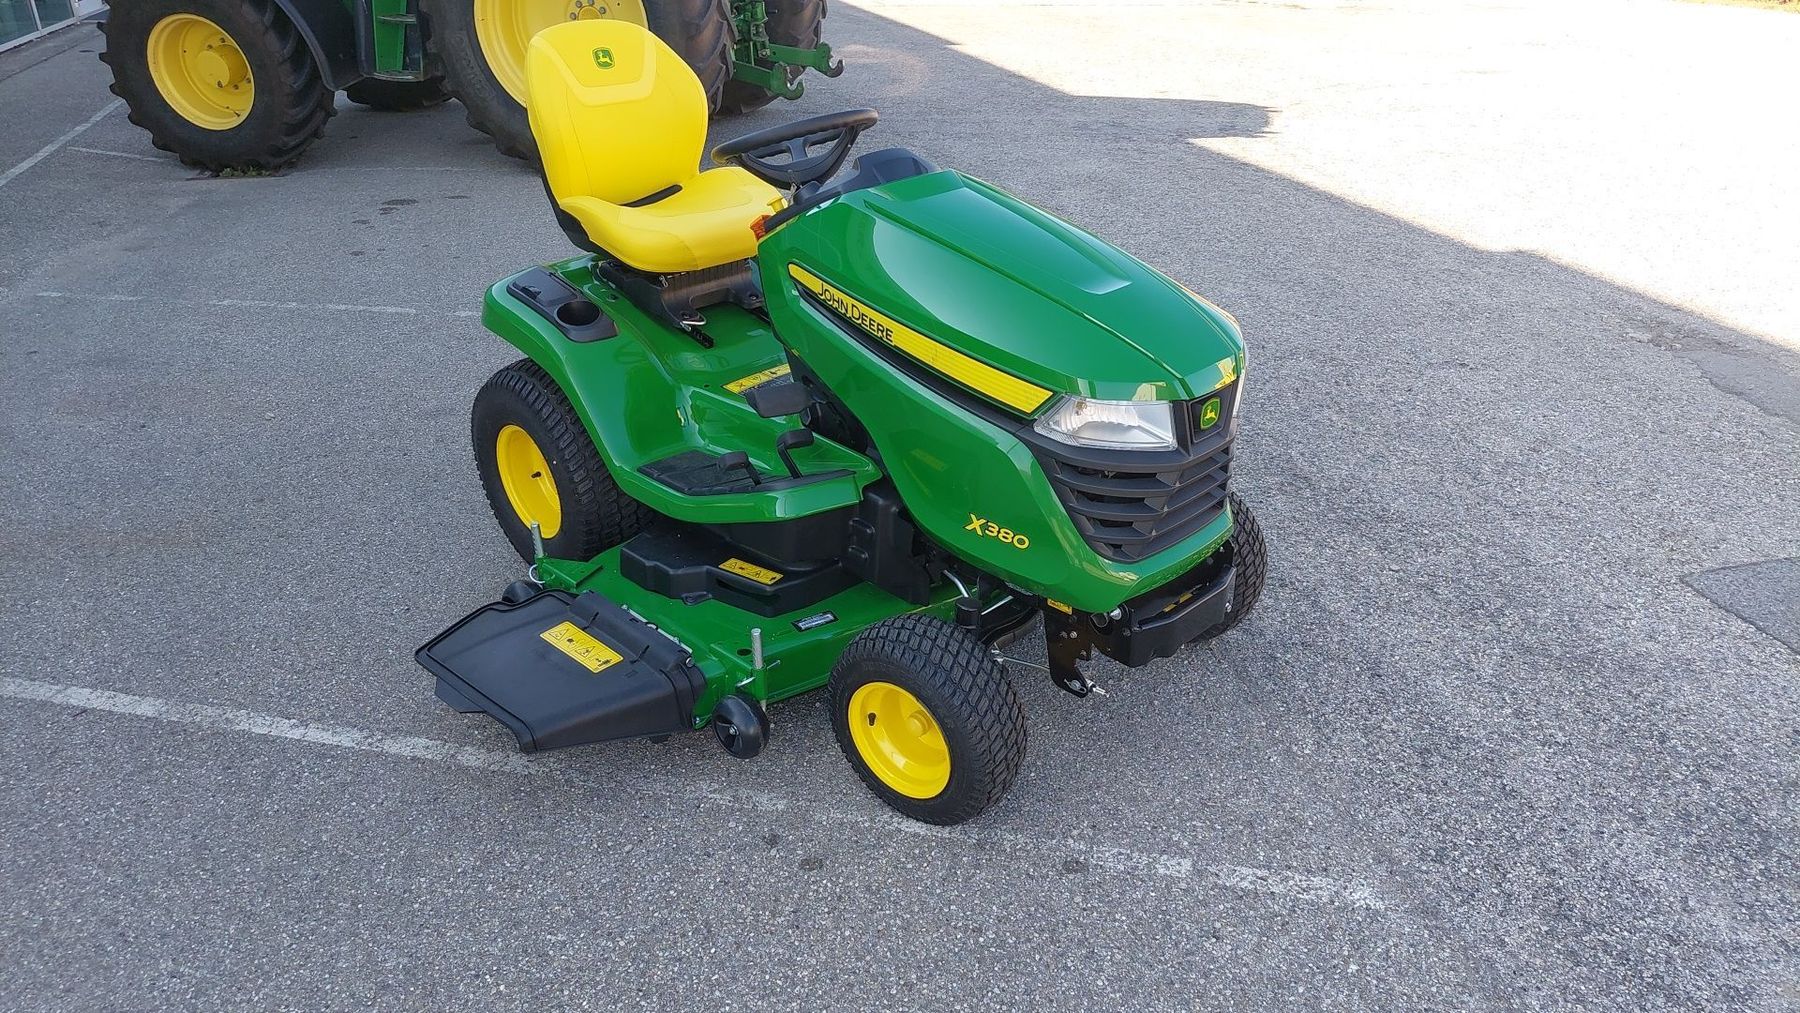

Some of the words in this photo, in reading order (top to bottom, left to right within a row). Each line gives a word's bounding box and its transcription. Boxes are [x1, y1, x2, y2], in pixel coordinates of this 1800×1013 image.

[817, 282, 849, 316] JOHN
[851, 303, 894, 343] DEERE
[963, 512, 1031, 550] X380
